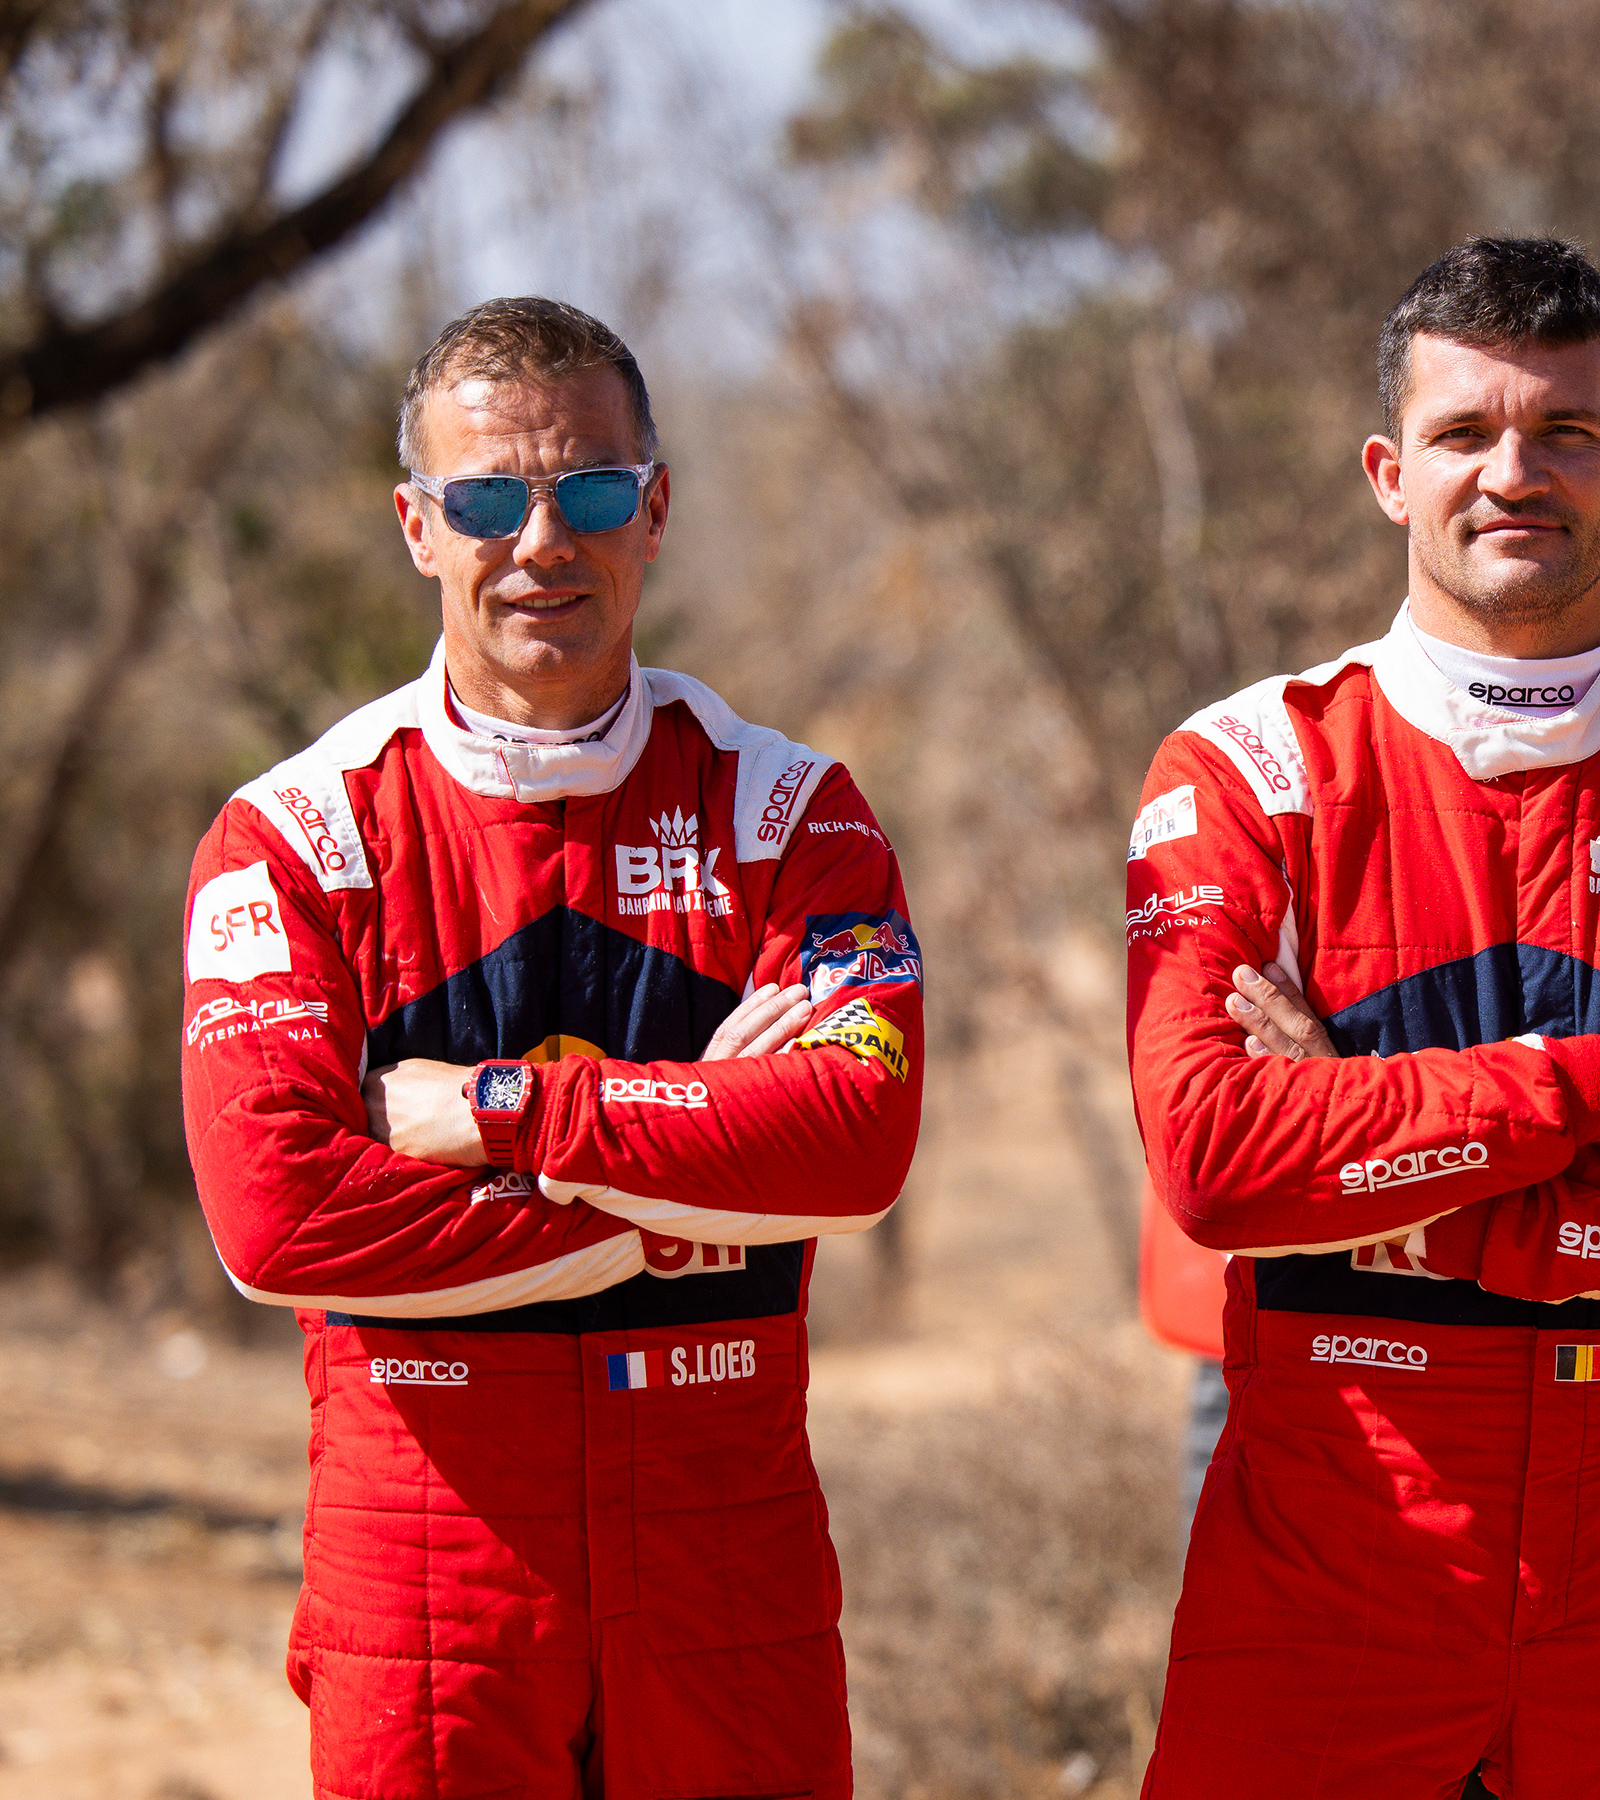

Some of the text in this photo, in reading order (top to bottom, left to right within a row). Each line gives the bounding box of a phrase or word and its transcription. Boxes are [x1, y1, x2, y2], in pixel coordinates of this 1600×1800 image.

[1468, 682, 1575, 708] sparco
[1211, 714, 1292, 795] sparco
[756, 759, 815, 846] sparco
[273, 786, 346, 877] sparco
[807, 820, 870, 837] RICHARD
[615, 843, 730, 897] BRX
[210, 899, 281, 952] SFR
[617, 891, 671, 916] BAHRAIN
[1127, 915, 1217, 947] ERNATIONAL
[1339, 1141, 1490, 1194] sparco
[369, 1357, 469, 1386] sparco
[670, 1339, 757, 1386] S.LOEB
[1310, 1334, 1428, 1371] sparco
